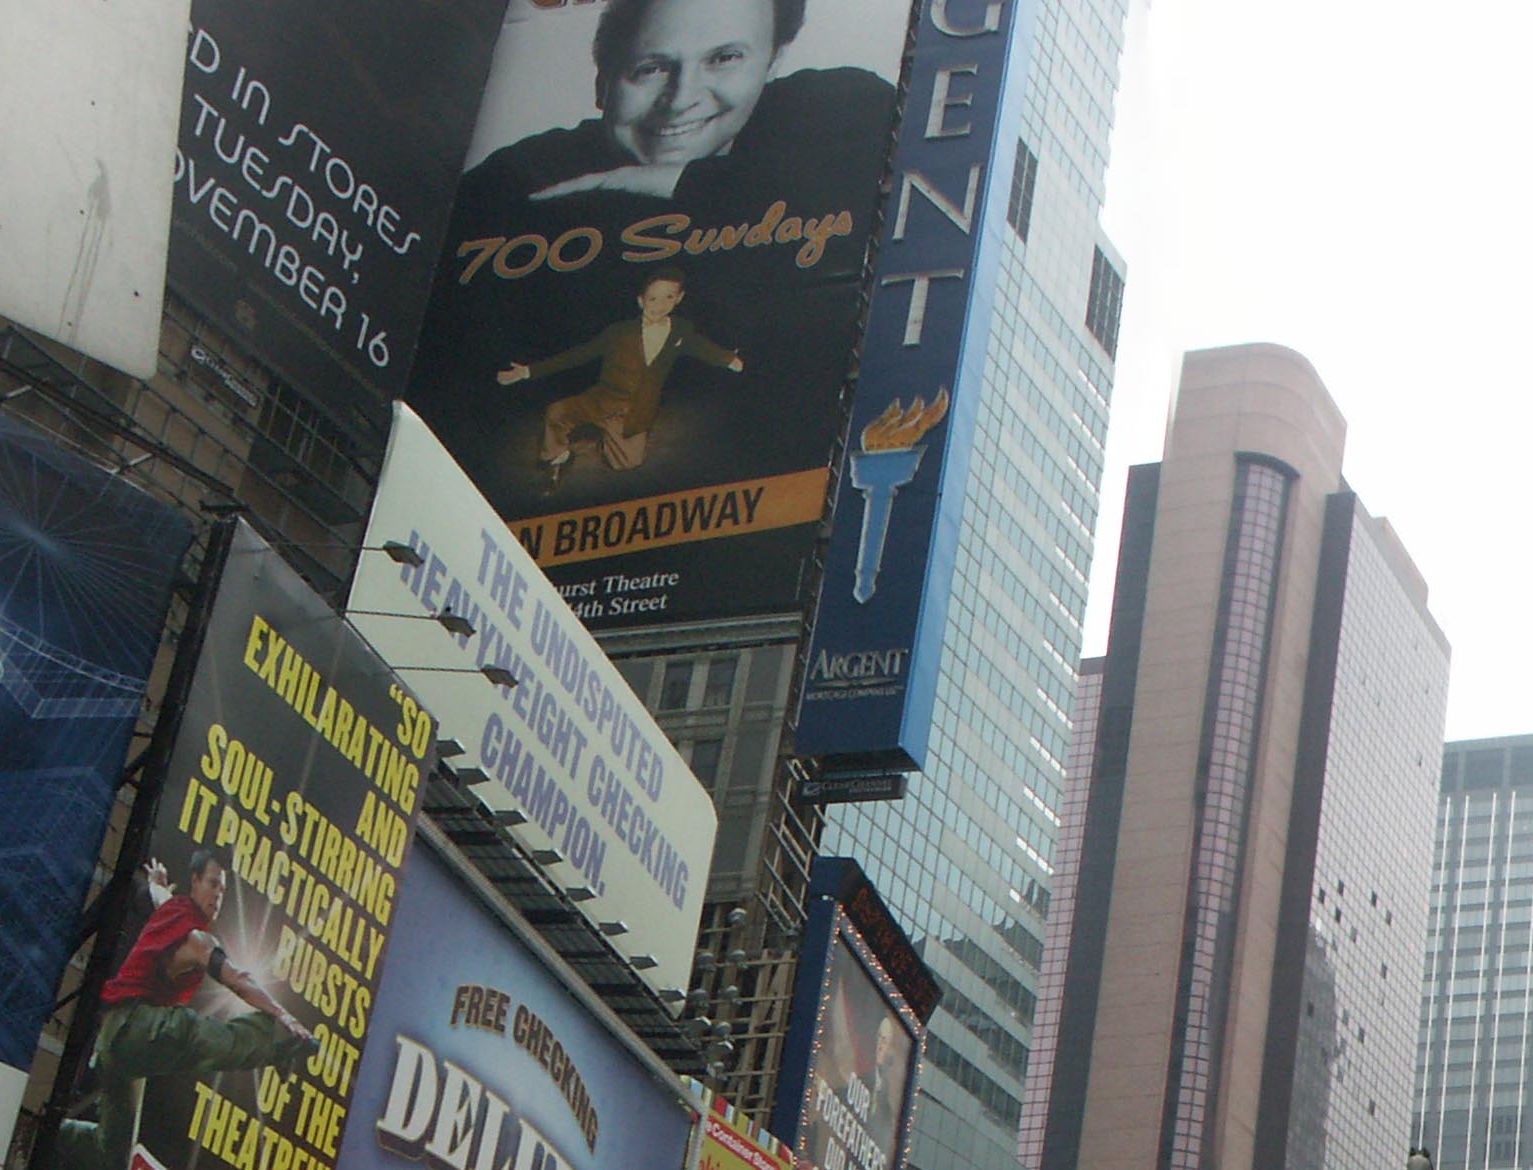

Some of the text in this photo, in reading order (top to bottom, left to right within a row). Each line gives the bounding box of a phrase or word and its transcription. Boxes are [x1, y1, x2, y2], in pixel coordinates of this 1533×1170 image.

[194, 93, 363, 284] TUESDAY,
[457, 201, 852, 285] 700 Sundays
[243, 615, 420, 816] EXHILARATING
[401, 530, 688, 911] HEAVYWEIGHT CHECKING
[478, 528, 664, 803] THE UNDISPUTED
[810, 649, 908, 683] ARGENT
[179, 778, 384, 981] IT PRACTICALLY
[201, 724, 395, 926] SOUL-STIRRING
[355, 790, 407, 868] AND
[479, 712, 608, 897] CHAMPION.
[273, 925, 371, 1039] BURSTS
[307, 1023, 361, 1097] OUT
[450, 985, 599, 1155] FREE CHECKING
[258, 1065, 346, 1159] OF THE
